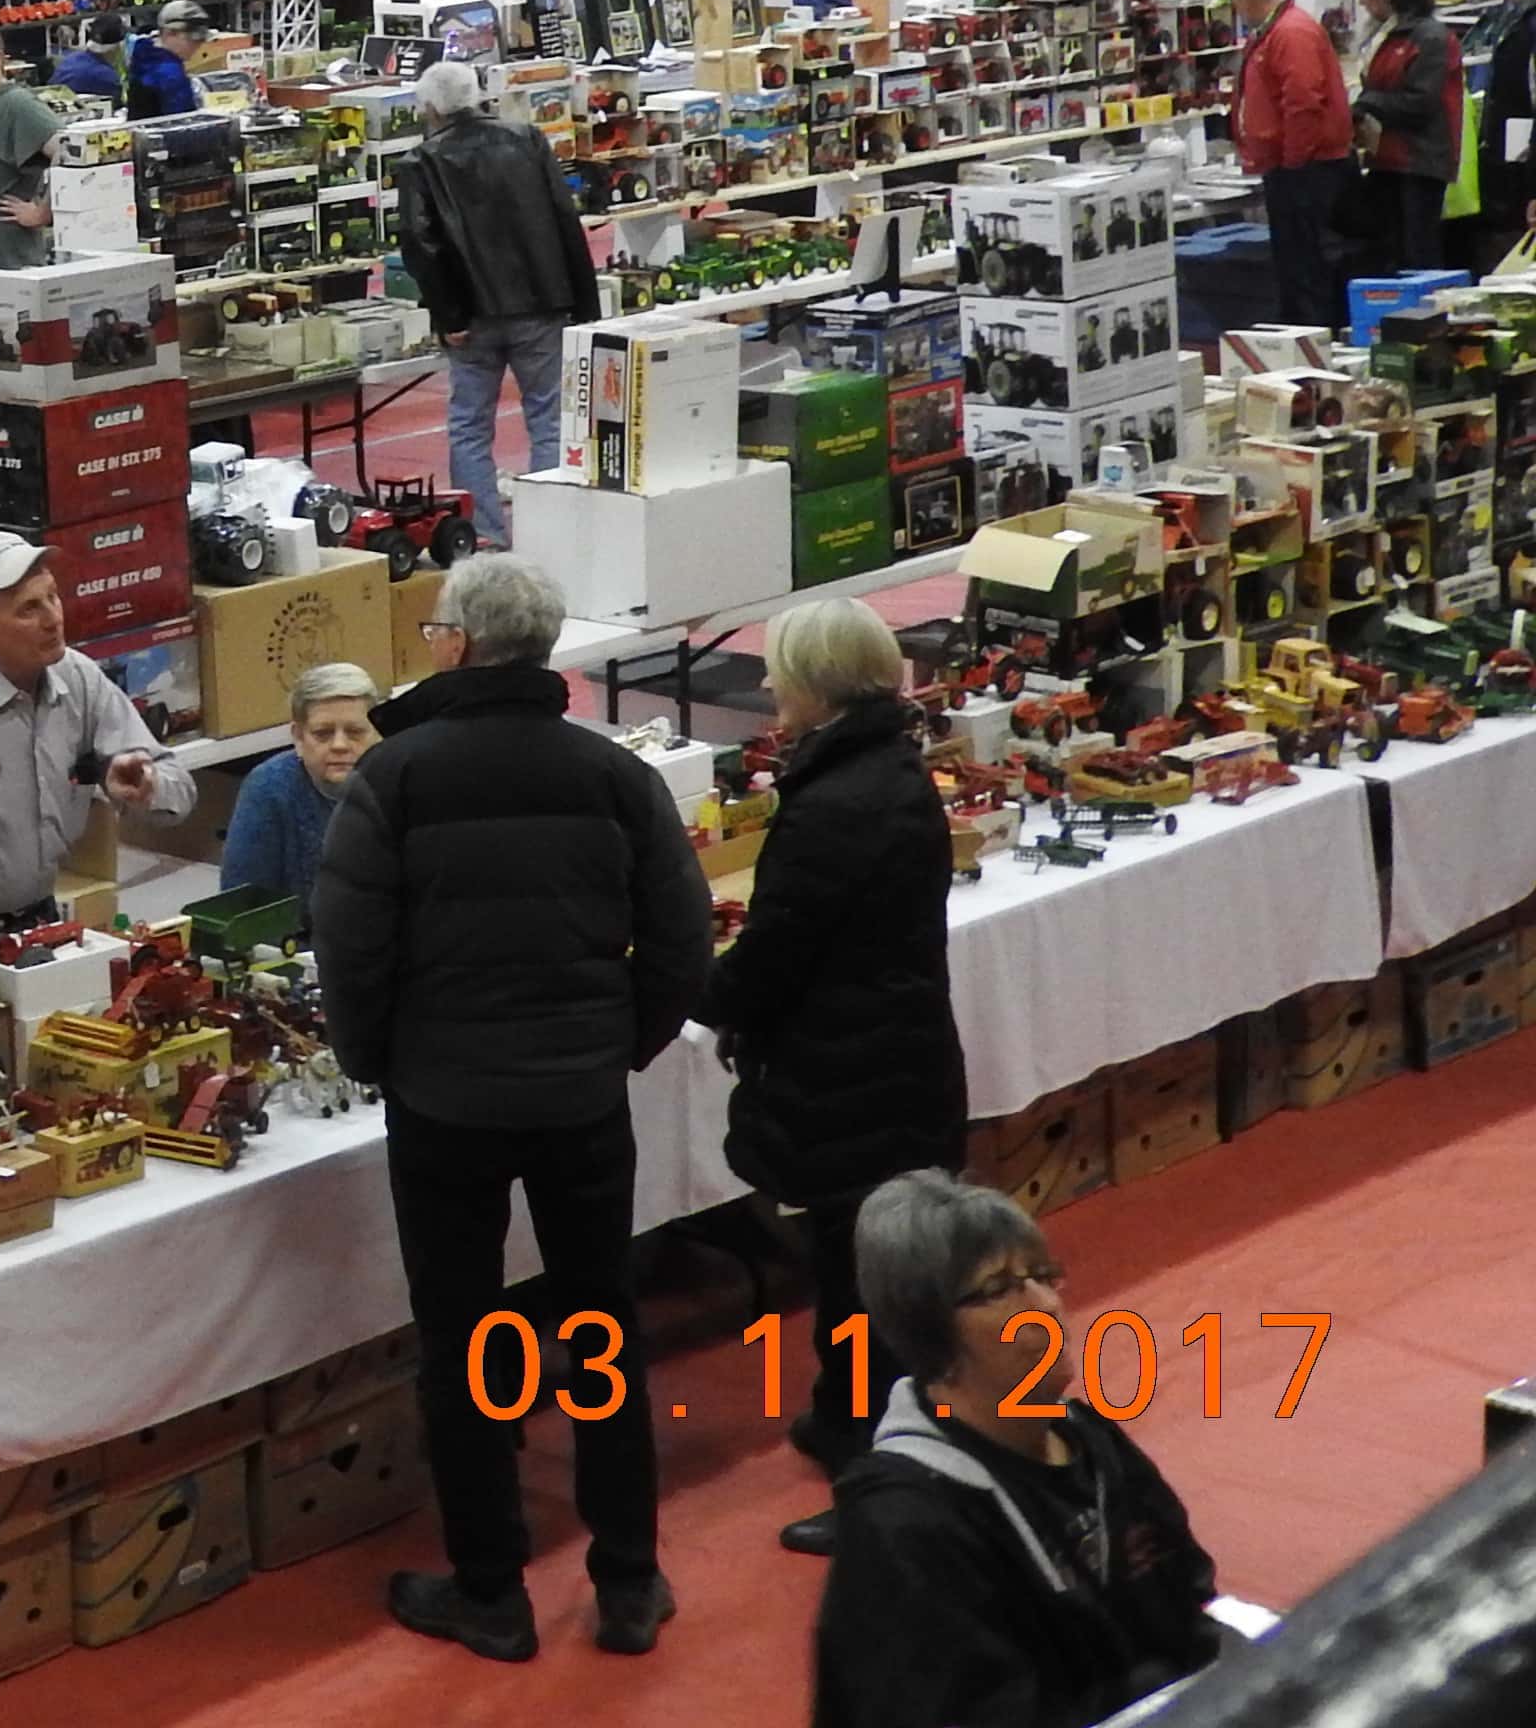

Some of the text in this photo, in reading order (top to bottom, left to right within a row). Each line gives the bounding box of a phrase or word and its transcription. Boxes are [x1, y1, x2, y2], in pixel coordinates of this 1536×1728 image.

[578, 357, 589, 419] 3000
[94, 411, 130, 429] CASE
[632, 346, 645, 488] Forage Harvester
[5, 458, 22, 469] 375
[77, 459, 106, 476] CASE
[121, 451, 141, 468] STX
[142, 446, 163, 464] 375
[93, 530, 130, 550] CASE
[77, 580, 106, 597] CASE
[121, 572, 141, 588] STX
